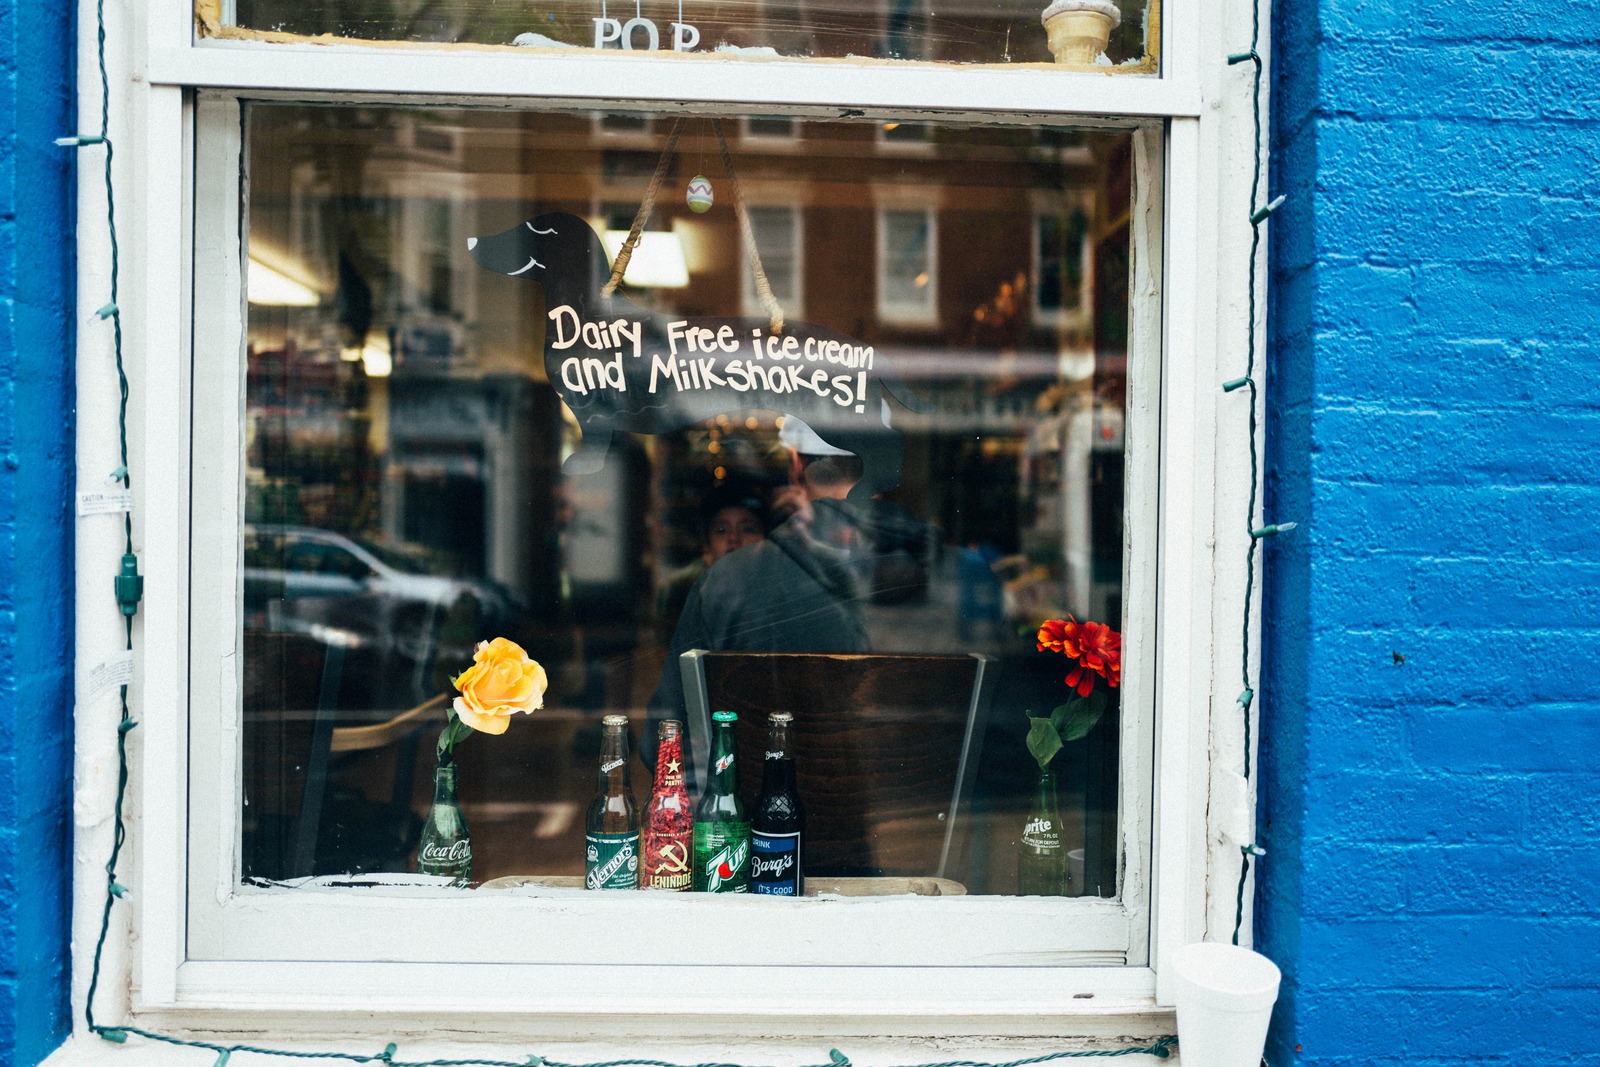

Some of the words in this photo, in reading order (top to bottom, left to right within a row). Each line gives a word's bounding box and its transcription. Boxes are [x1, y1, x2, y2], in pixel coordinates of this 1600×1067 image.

[592, 17, 700, 52] POP
[548, 305, 641, 357] Dairy
[667, 320, 740, 355] Free
[561, 353, 627, 396] and
[1023, 817, 1051, 837] prite
[586, 842, 633, 890] Vernors
[650, 872, 692, 888] LENINADE
[706, 839, 748, 893] 7UP
[751, 854, 794, 878] Barq's
